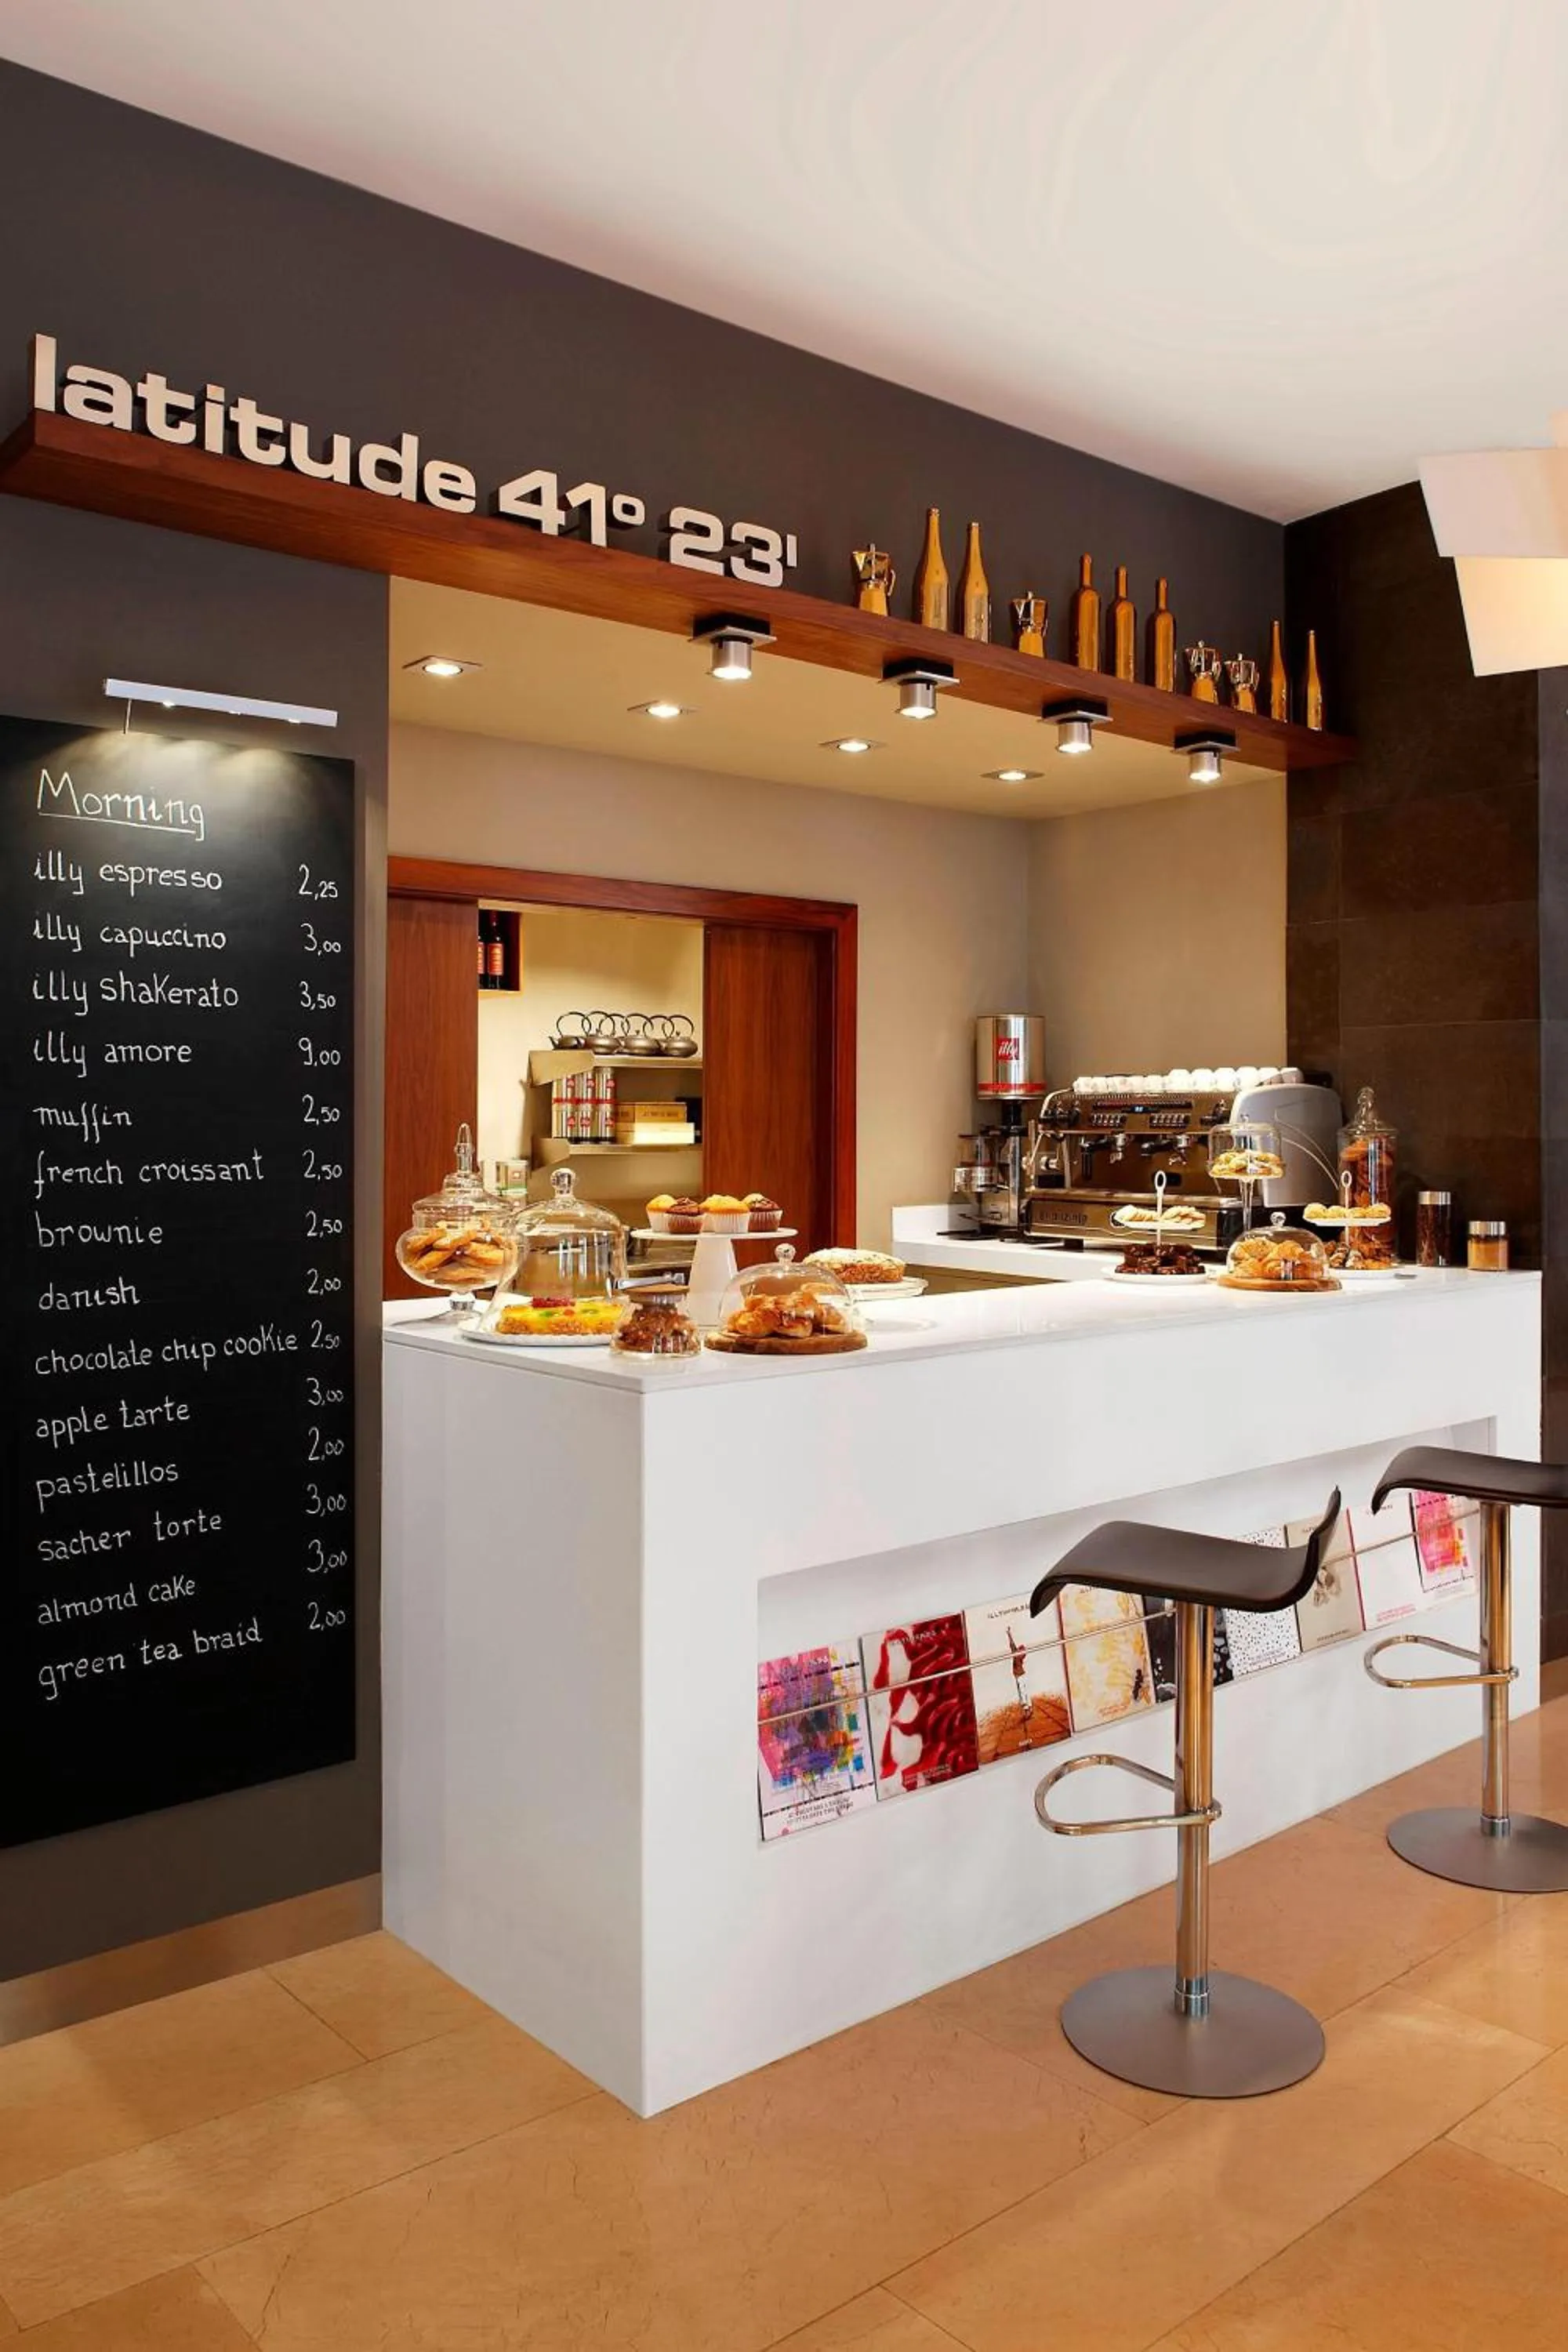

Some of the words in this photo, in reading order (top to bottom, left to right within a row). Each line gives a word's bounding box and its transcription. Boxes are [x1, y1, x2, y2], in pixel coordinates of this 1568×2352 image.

[34, 333, 477, 514] latitude
[38, 768, 205, 841] Morning
[33, 850, 84, 895] illy
[100, 863, 223, 898] espresso
[298, 864, 339, 900] 2,25
[33, 911, 82, 953] illy
[100, 922, 227, 958] capuccino
[300, 923, 342, 956] 3,00
[32, 970, 89, 1017] illy
[299, 980, 336, 1010] 3,50
[33, 1030, 87, 1078] illy
[103, 1042, 192, 1064] amore
[33, 1102, 132, 1145] muffin
[302, 1094, 340, 1126] 2,50
[34, 1150, 124, 1200] french
[139, 1148, 264, 1183] croissant
[302, 1149, 343, 1181] 2,50
[35, 1210, 163, 1248] brownie
[305, 1210, 343, 1237] 2,50
[38, 1276, 141, 1311] danish
[307, 1268, 342, 1296] 2,00
[35, 1338, 153, 1375] chocolate
[162, 1338, 216, 1372] chip
[306, 1377, 344, 1406] 3,00
[36, 1406, 110, 1449] apple
[119, 1396, 191, 1429] tarte
[36, 1461, 179, 1513] pastelillos
[305, 1483, 347, 1517] 3,00
[38, 1530, 132, 1562] sacher
[154, 1509, 222, 1541] torte
[307, 1539, 347, 1573] 3,00
[38, 1582, 139, 1625] almond
[307, 1602, 346, 1632] 2,00
[38, 1653, 126, 1700] green
[140, 1639, 183, 1665] tea
[193, 1617, 263, 1654] braid
